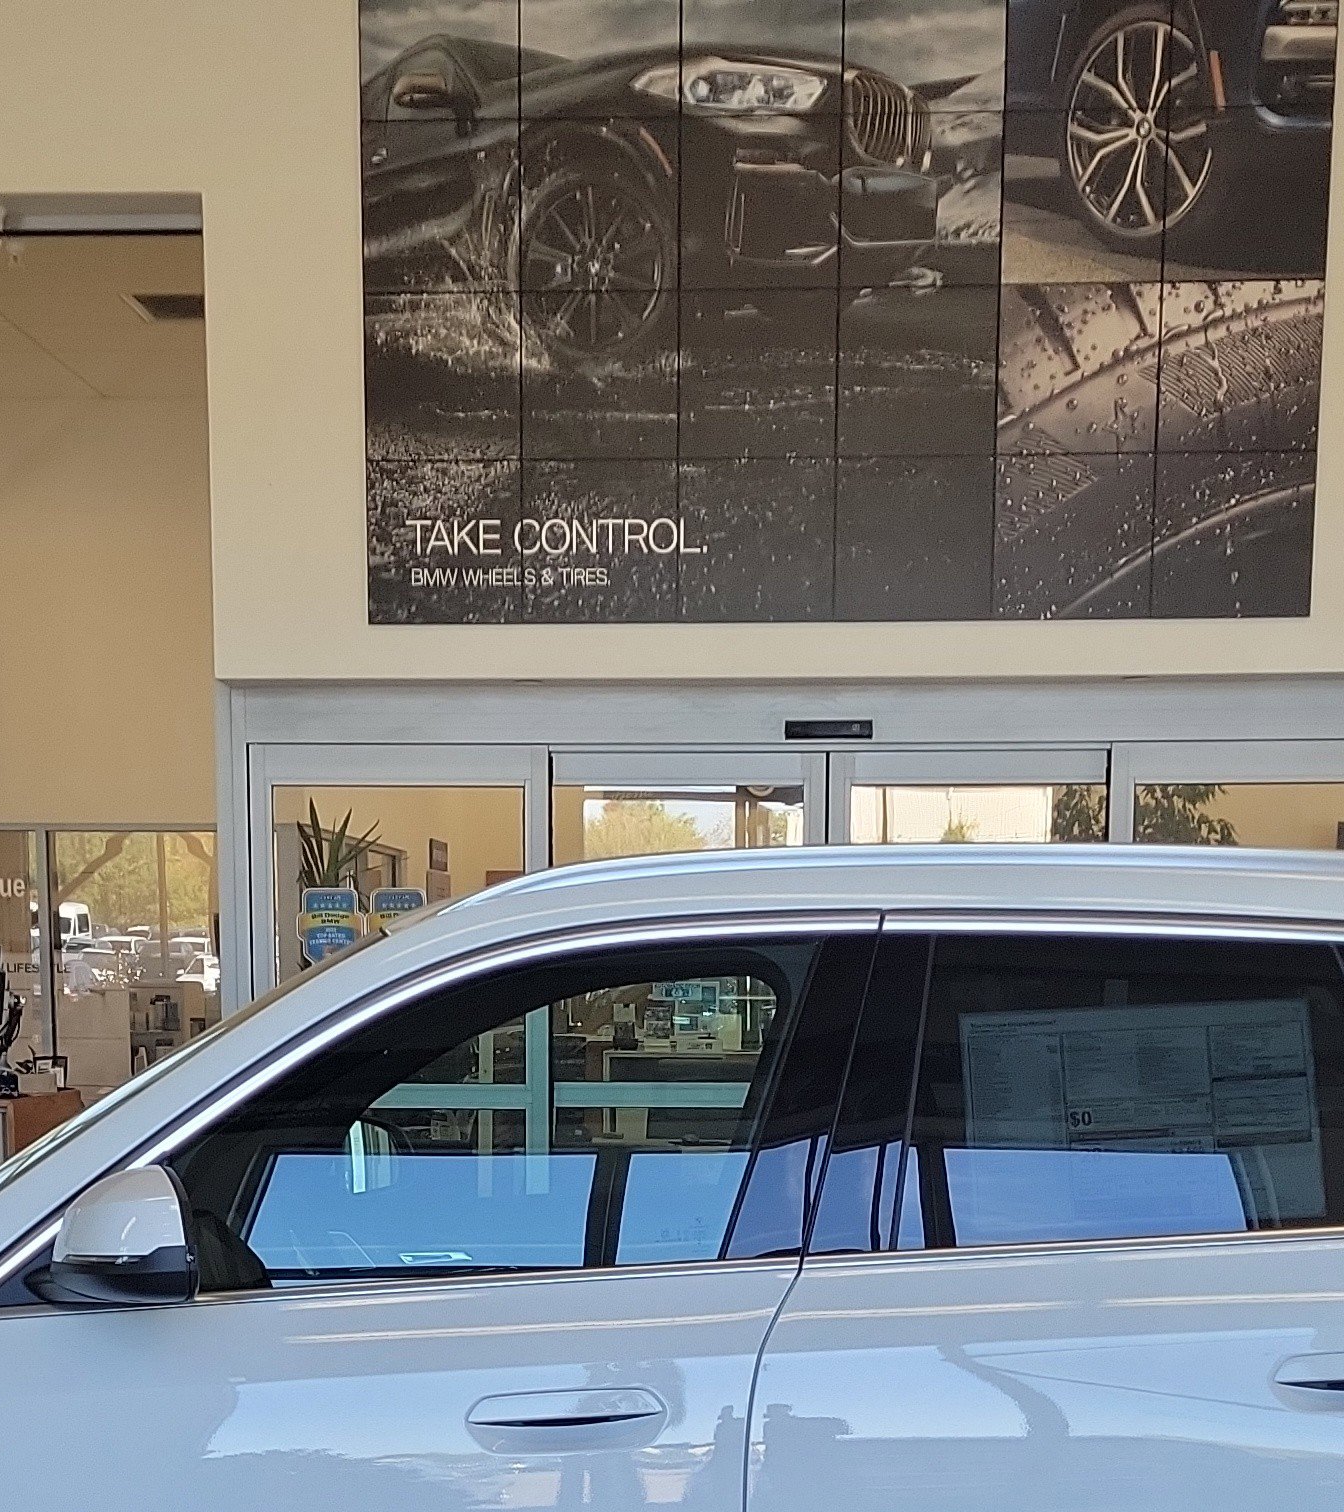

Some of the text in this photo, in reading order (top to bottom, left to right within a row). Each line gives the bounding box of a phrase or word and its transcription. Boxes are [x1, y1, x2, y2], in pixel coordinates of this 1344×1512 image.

[406, 517, 709, 556] TAKE CONTROL.
[411, 567, 459, 587] BMW
[462, 567, 536, 587] WHEELS
[540, 567, 555, 587] &
[6, 962, 72, 974] LIFESLE
